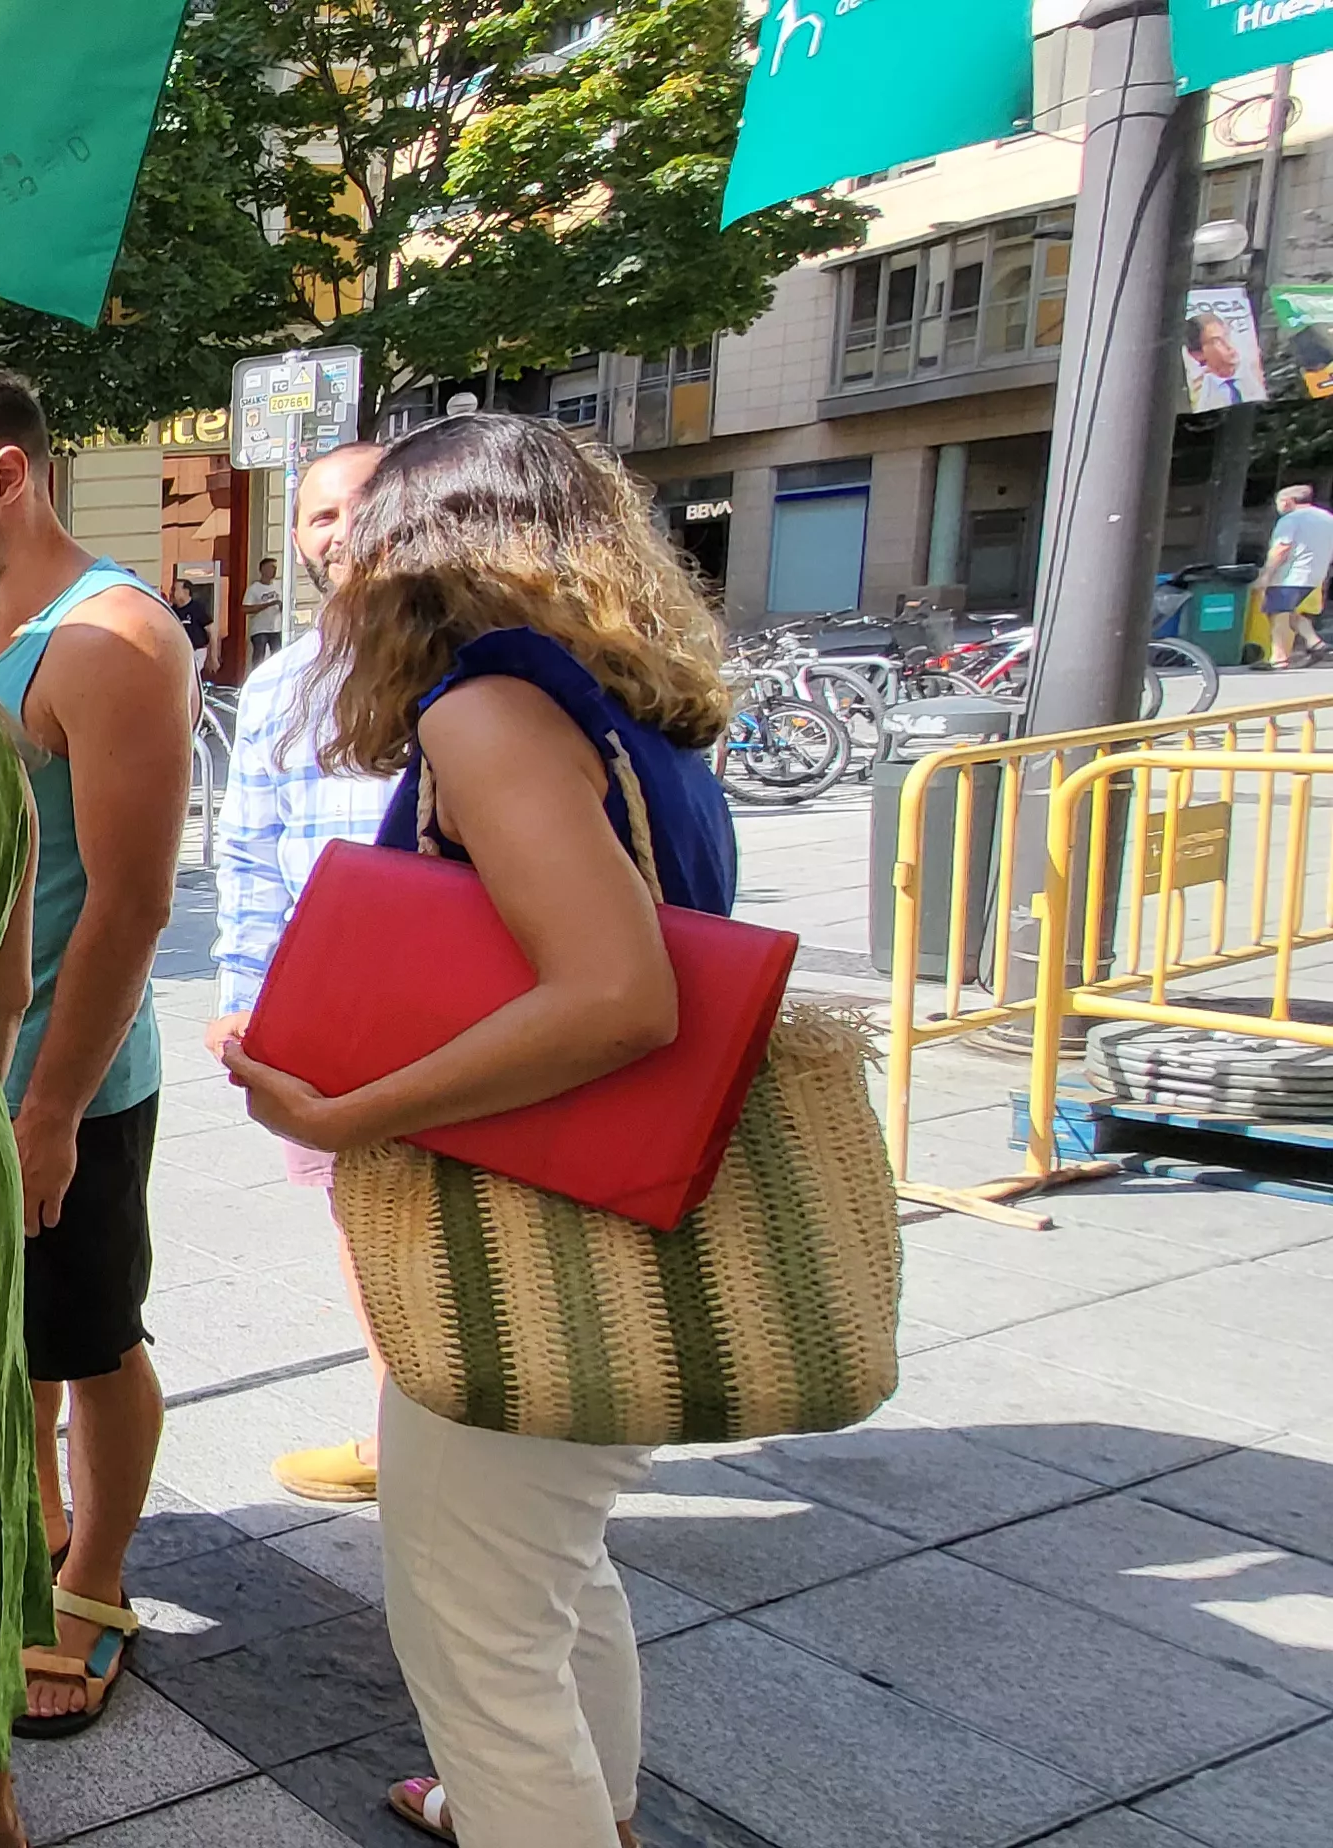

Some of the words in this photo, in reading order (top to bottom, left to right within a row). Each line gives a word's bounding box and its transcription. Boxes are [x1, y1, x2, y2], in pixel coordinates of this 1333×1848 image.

[1235, 0, 1333, 34] Hues
[273, 382, 289, 393] TC
[686, 500, 733, 520] BBVA
